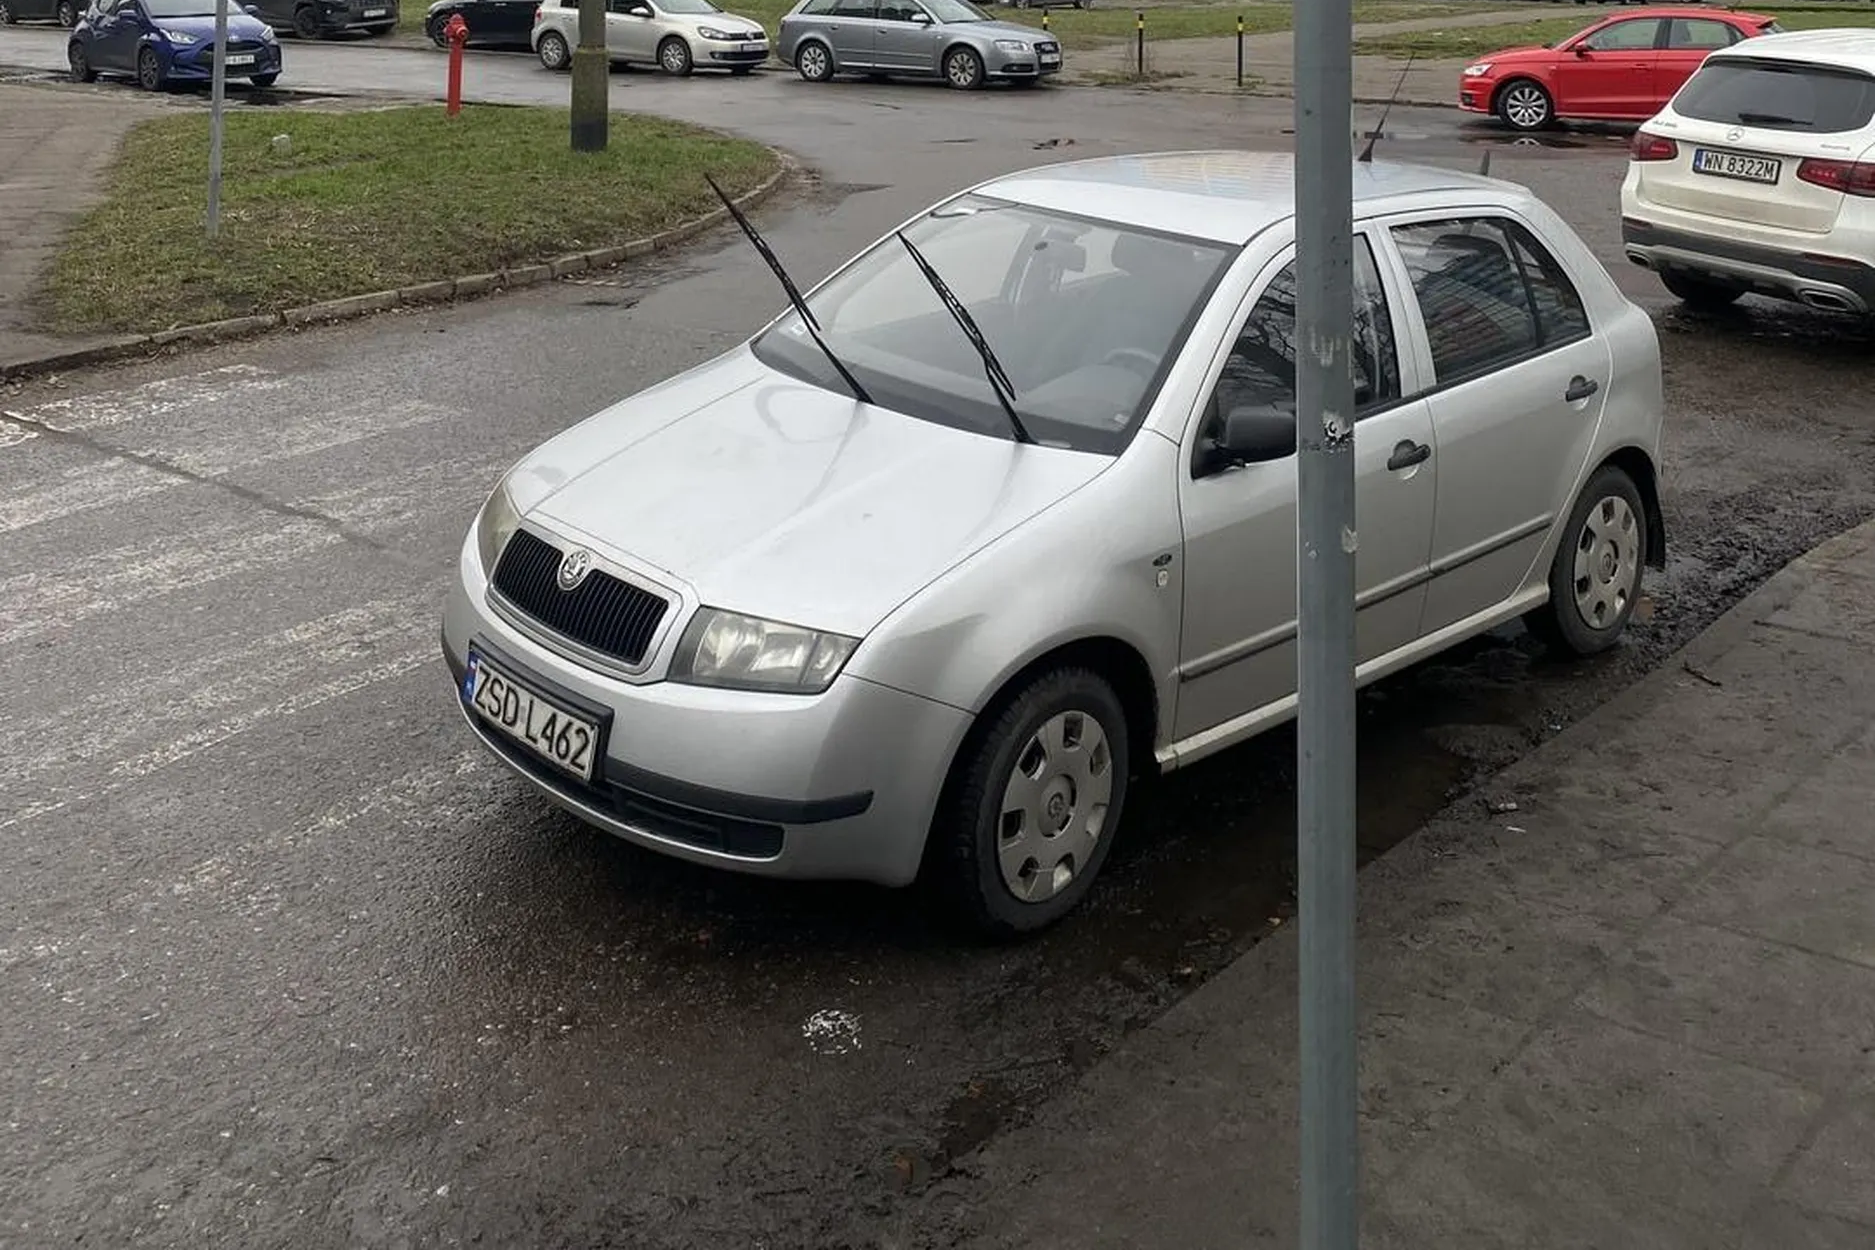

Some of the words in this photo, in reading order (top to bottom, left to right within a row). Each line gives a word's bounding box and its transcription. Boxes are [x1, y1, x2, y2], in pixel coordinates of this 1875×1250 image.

[1704, 152, 1724, 171] WN
[1727, 157, 1775, 178] 8322M
[475, 666, 520, 727] ZSD
[525, 699, 589, 771] L462
